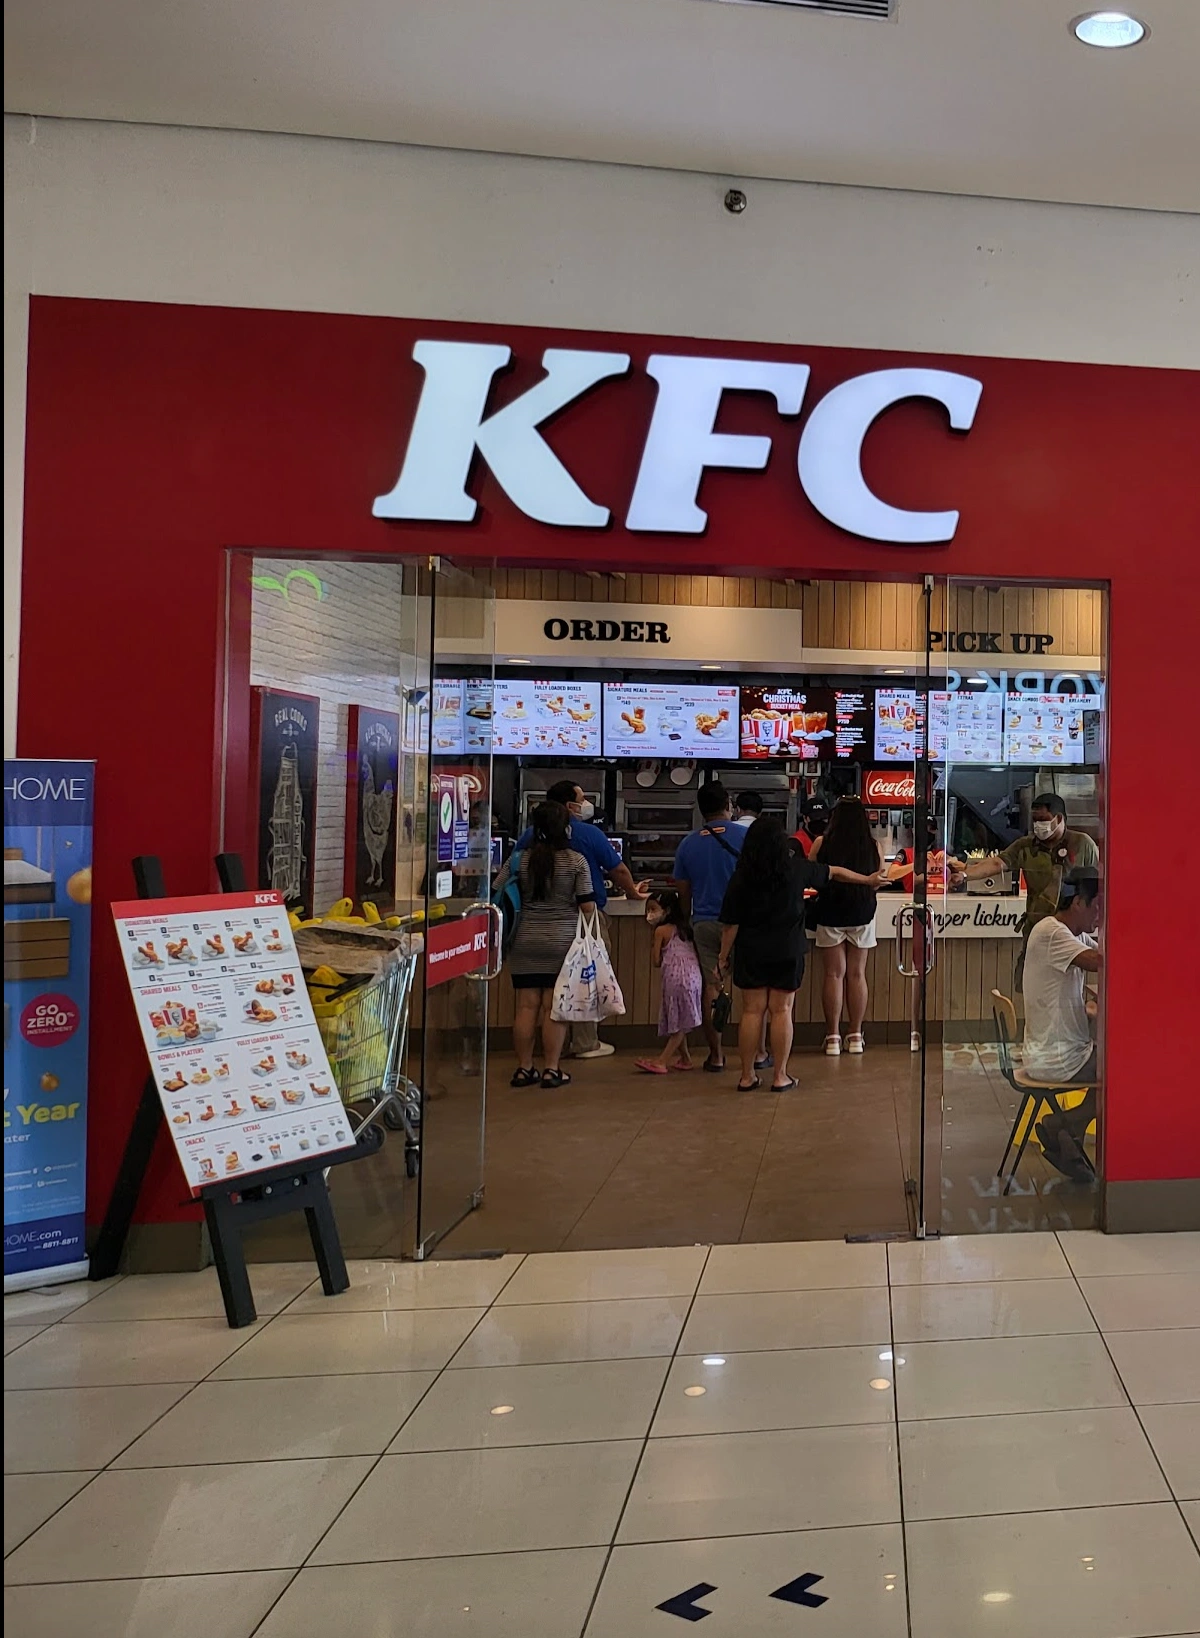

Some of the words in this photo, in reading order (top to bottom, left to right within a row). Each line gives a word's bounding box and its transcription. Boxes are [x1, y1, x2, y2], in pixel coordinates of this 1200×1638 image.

[371, 339, 984, 544] KFC
[543, 618, 671, 643] ORDER
[927, 631, 1001, 653] PICK
[1010, 633, 1053, 654] UP
[763, 692, 807, 704] CHRISTMAS
[255, 893, 278, 904] KFC
[429, 951, 445, 964] Welcome
[473, 931, 487, 951] KFC
[140, 987, 162, 996] SHARED
[162, 984, 182, 994] MEALS
[35, 1004, 59, 1016] GO
[26, 1026, 74, 1035] INSTALLMENT
[157, 1053, 176, 1061] BOWLS
[16, 1102, 80, 1125] Year
[242, 1123, 262, 1133] EXTRAS
[42, 1237, 79, 1249] 8811-8811
